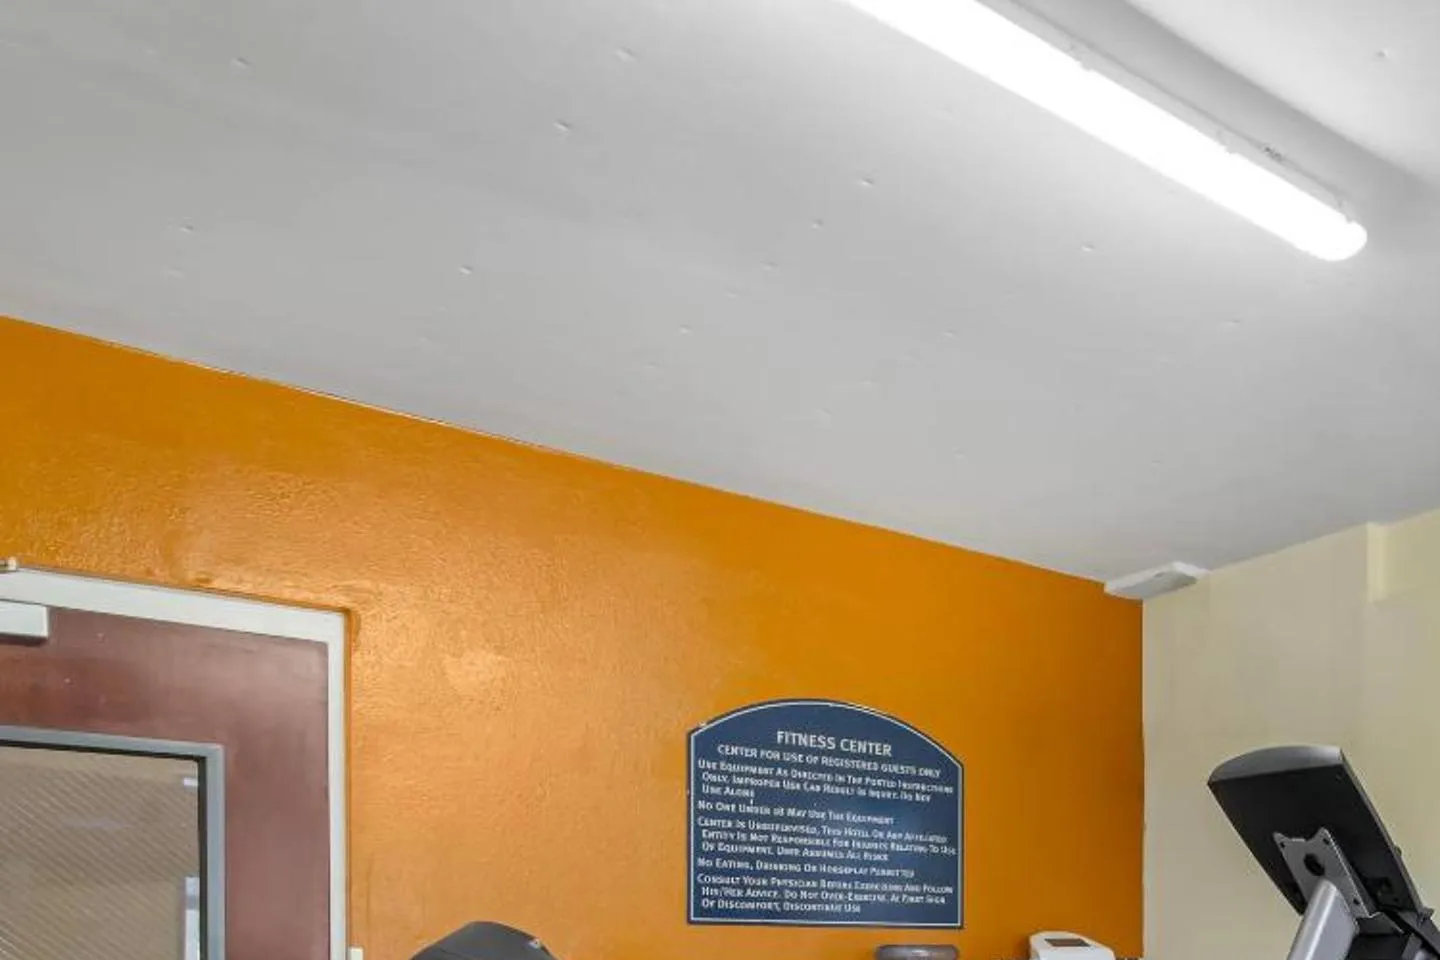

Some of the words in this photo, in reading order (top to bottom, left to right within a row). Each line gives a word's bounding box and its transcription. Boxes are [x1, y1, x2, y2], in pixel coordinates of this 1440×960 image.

[776, 731, 836, 750] FITNESS
[840, 738, 892, 757] CENTER
[717, 744, 757, 758] CENTER
[760, 749, 780, 760] FOR
[783, 752, 803, 763] USE
[806, 754, 819, 764] OF
[821, 755, 879, 771] REGISTERED
[881, 763, 916, 775] GUESTS
[918, 767, 941, 778] ONLY
